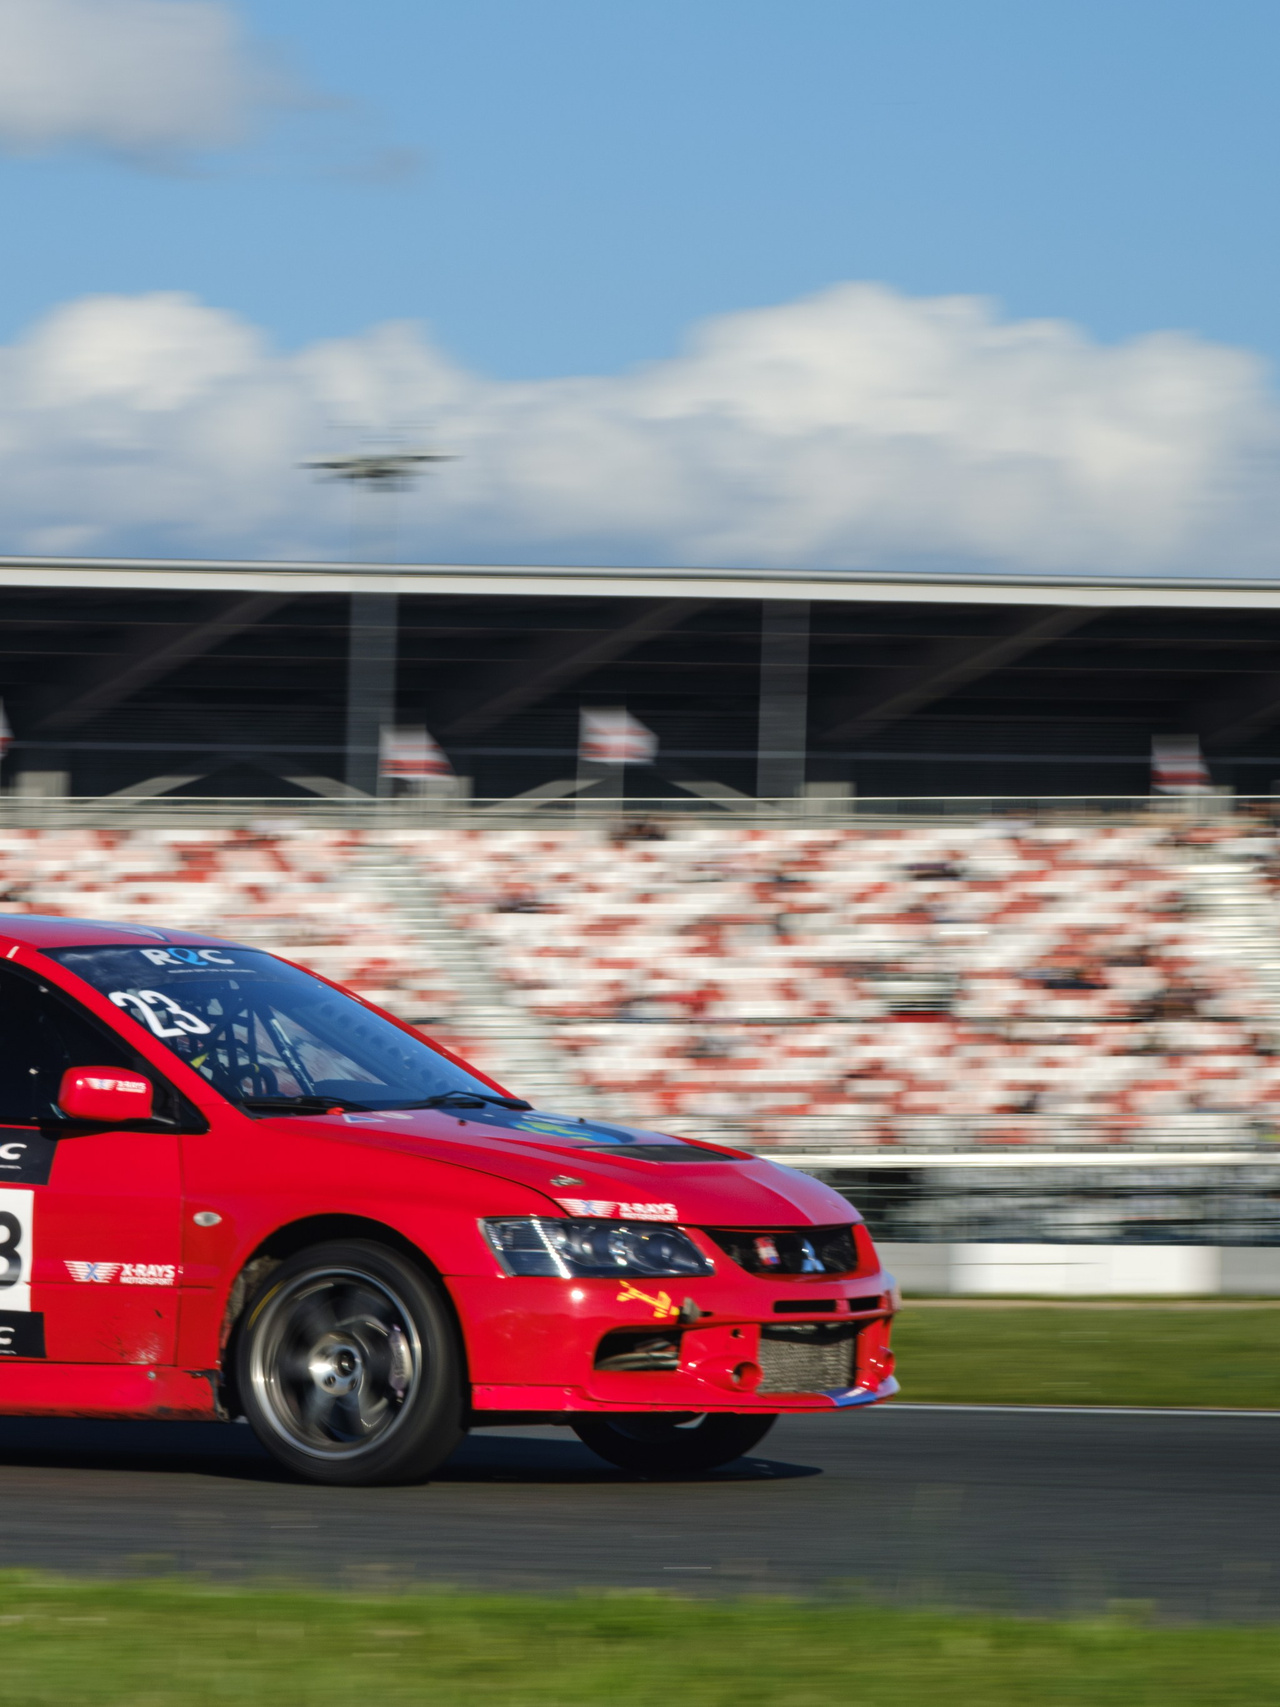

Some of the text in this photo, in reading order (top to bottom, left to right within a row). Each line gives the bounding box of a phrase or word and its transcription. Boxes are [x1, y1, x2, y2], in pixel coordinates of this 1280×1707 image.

[108, 989, 211, 1038] 23
[619, 1202, 678, 1215] X-RAYS
[120, 1263, 175, 1278] X-RAYS
